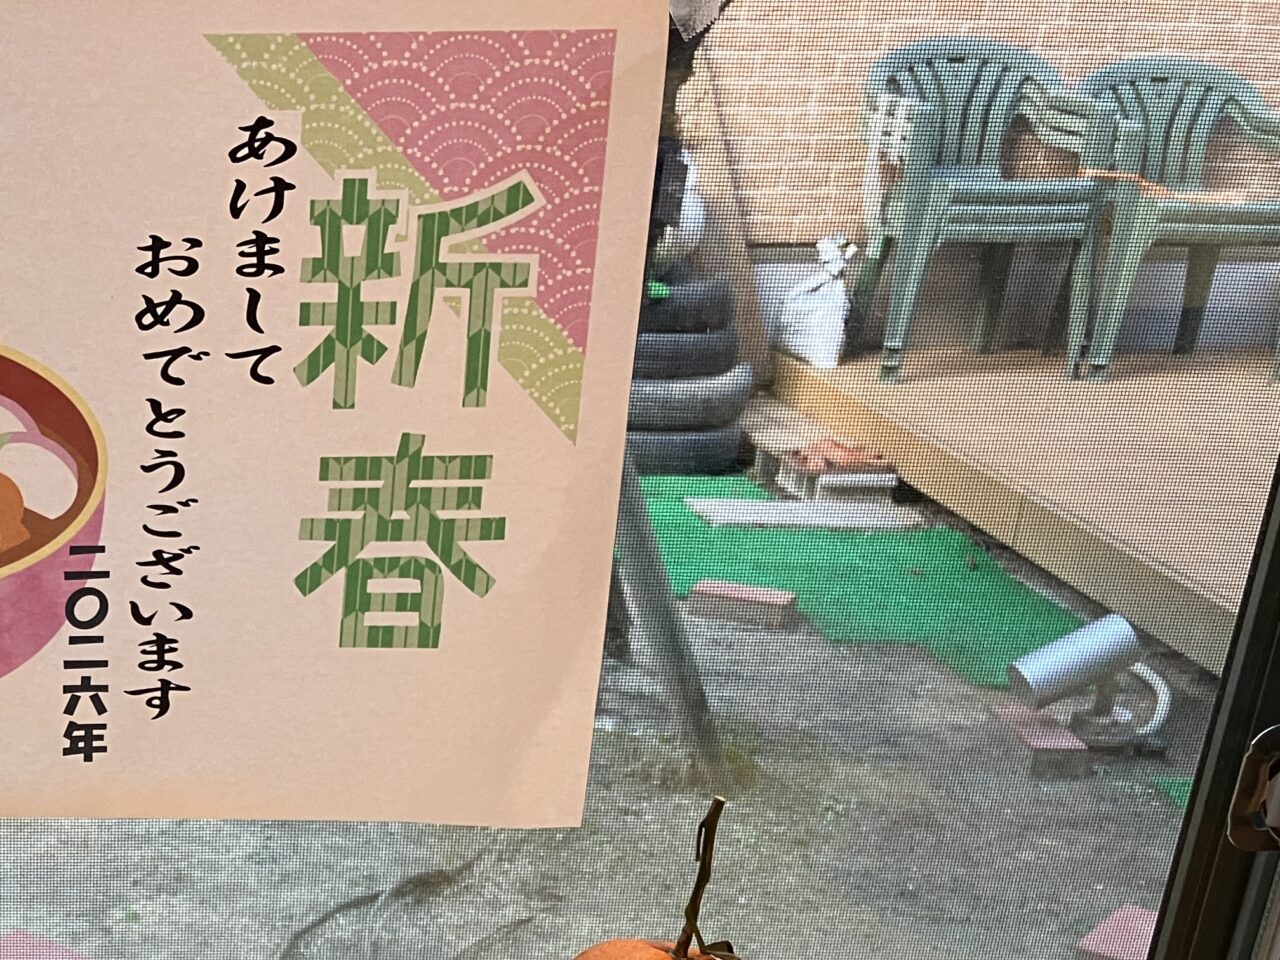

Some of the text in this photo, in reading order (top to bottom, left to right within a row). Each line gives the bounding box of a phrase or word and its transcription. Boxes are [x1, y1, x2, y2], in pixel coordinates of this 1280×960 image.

[124, 234, 211, 720] おめでとうございます
[225, 115, 298, 386] あけまして
[293, 177, 536, 650] 新春
